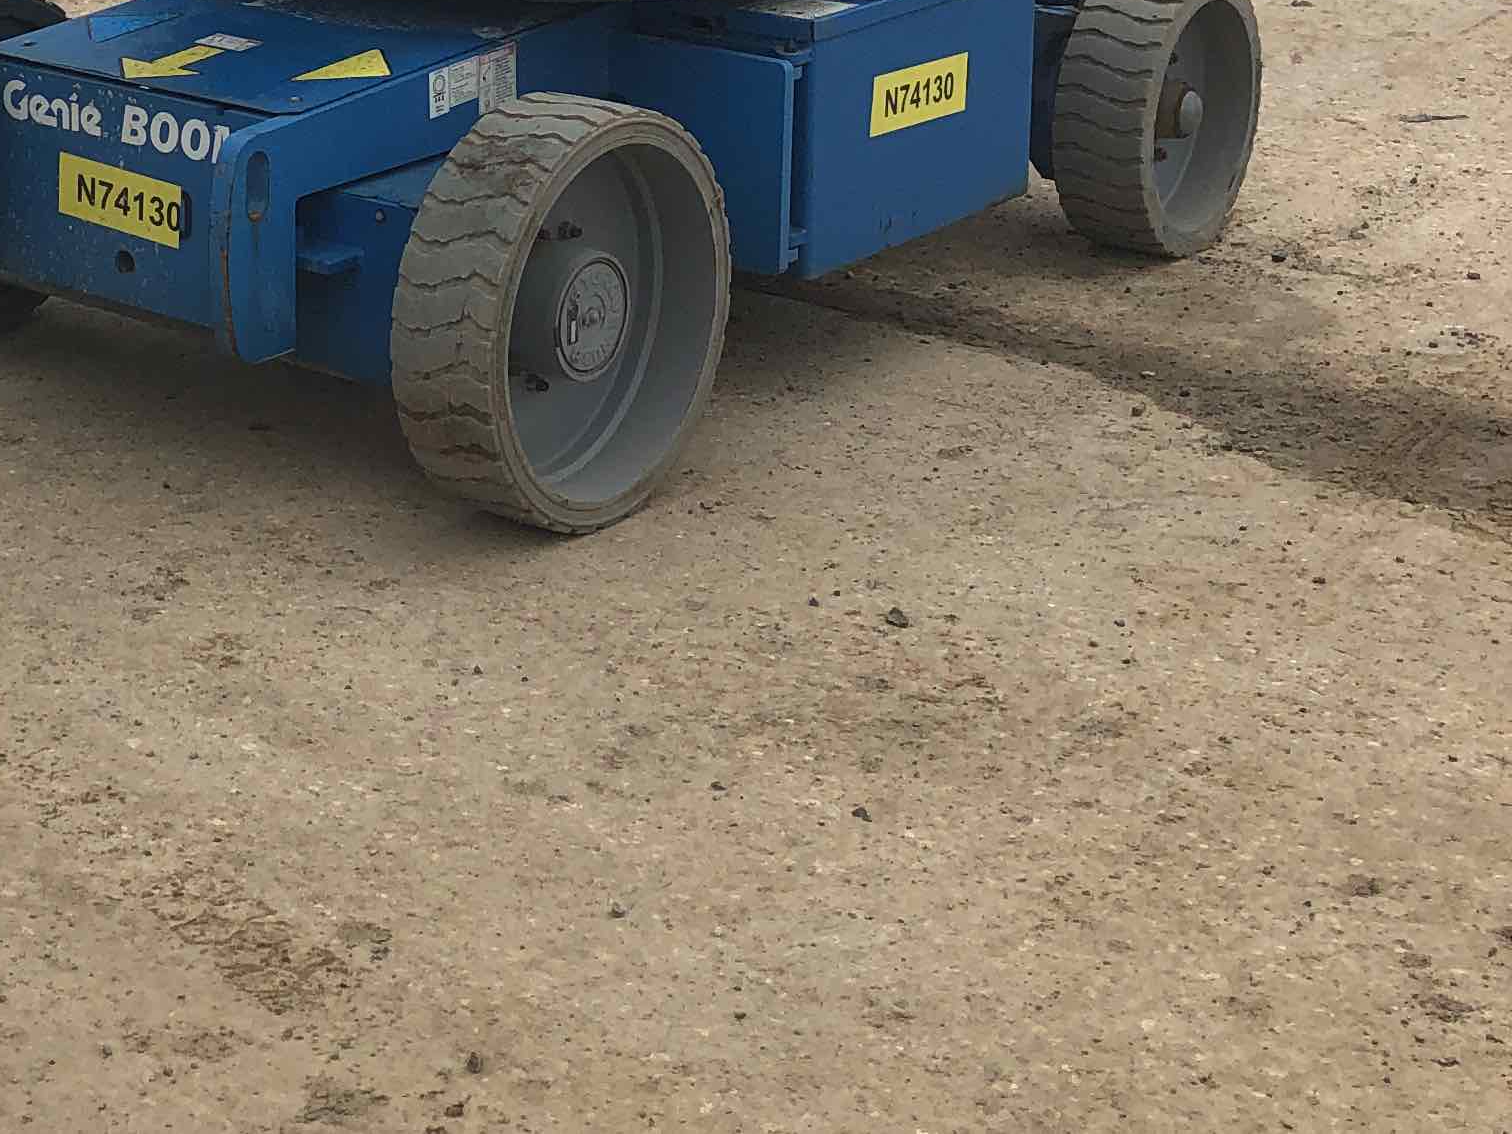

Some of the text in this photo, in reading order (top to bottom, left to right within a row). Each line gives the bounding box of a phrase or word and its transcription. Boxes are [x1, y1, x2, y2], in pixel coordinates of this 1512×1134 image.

[3, 79, 102, 137] Genie
[884, 72, 954, 118] N74130
[77, 174, 181, 232] N74130
